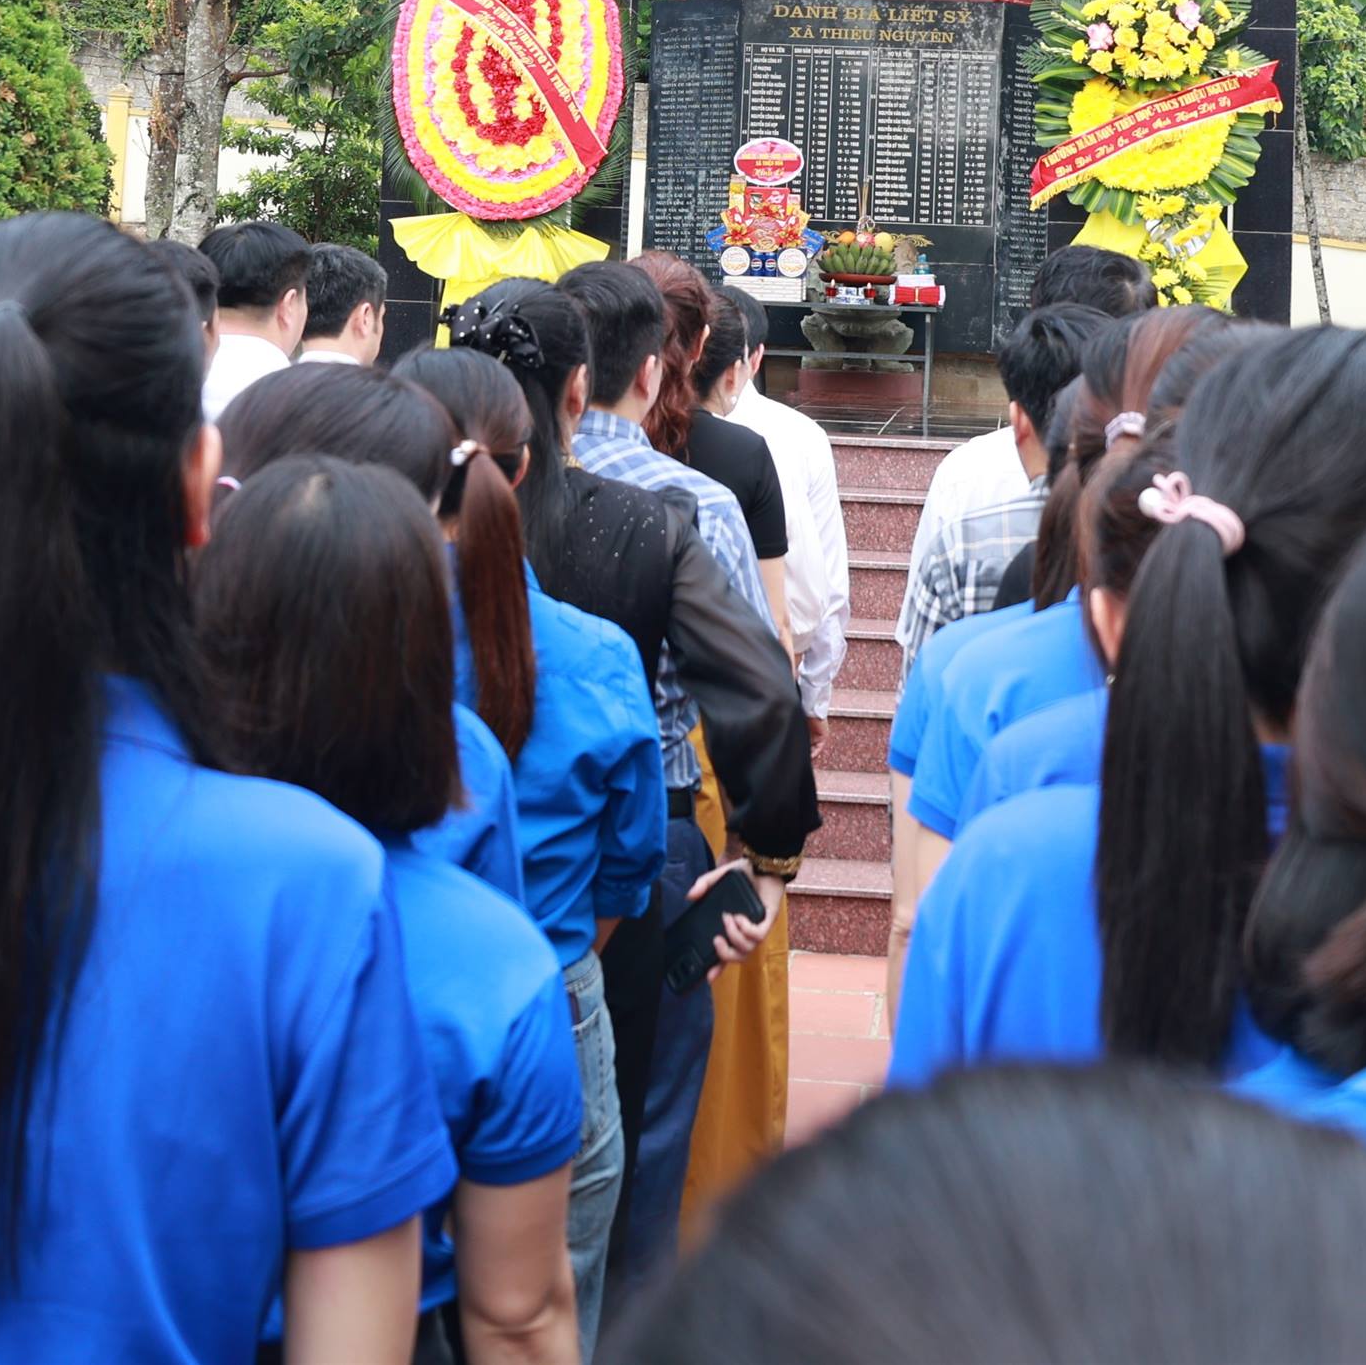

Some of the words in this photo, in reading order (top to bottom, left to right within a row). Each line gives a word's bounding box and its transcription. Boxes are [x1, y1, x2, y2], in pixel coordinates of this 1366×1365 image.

[773, 4, 838, 20] DANH
[887, 6, 939, 25] LIỆT
[788, 24, 816, 39] XÃ
[819, 26, 873, 43] THIỆU
[878, 27, 956, 44] NGUYÊN
